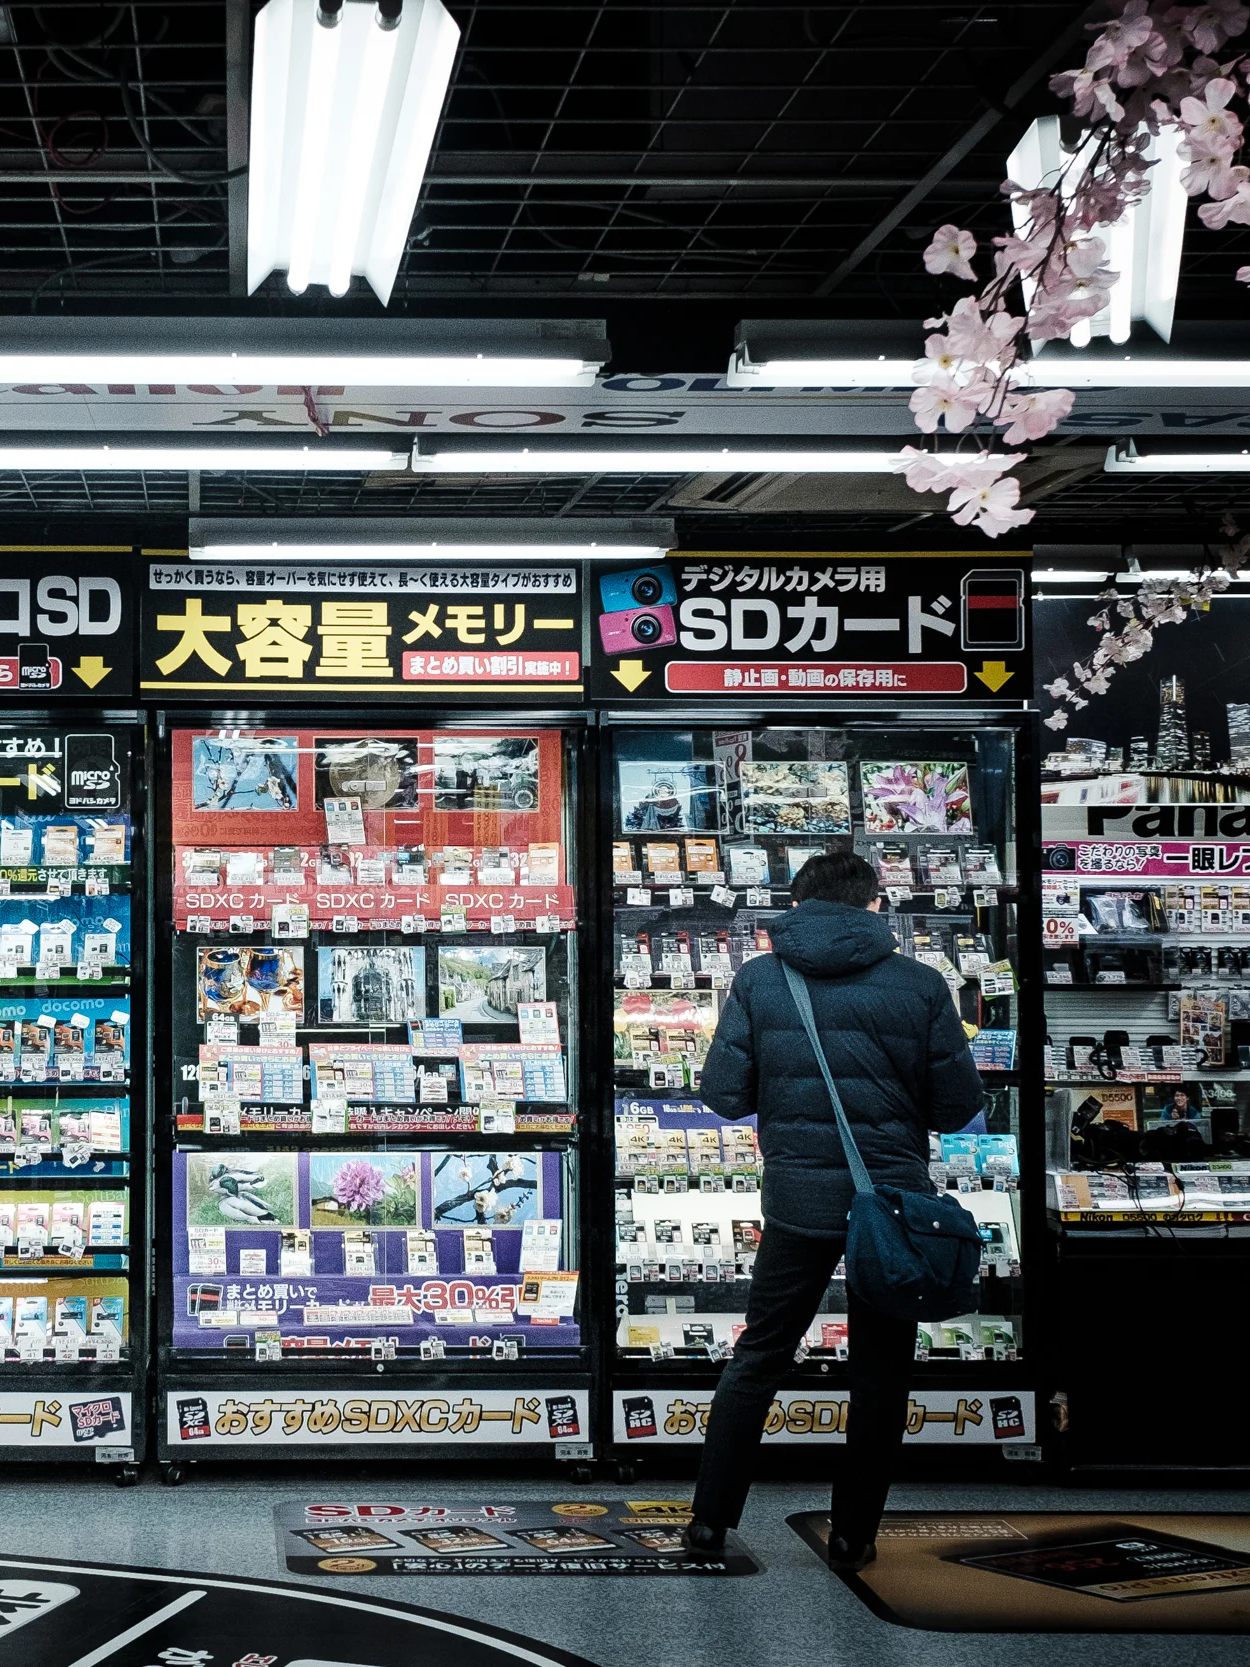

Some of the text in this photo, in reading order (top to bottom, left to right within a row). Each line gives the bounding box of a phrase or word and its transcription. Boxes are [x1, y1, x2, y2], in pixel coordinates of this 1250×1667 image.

[191, 409, 688, 430] SONY
[681, 566, 886, 593] デジタルカメラ用
[679, 595, 956, 654] SDカード
[155, 599, 574, 678] 大容量 メモリー
[724, 668, 907, 688] 静止画・動画の保存用に
[1079, 844, 1162, 858] こだわりの写真
[1165, 846, 1250, 872] 一眼レ
[185, 892, 301, 909] SDXC カード
[316, 892, 431, 909] SDXC カード
[444, 892, 561, 909] SDXC カード
[1042, 918, 1075, 934] 0%
[42, 997, 105, 1014] docomo
[180, 1064, 200, 1081] 12
[668, 1134, 684, 1144] 4K
[702, 1134, 717, 1144] 4K
[736, 1132, 752, 1142] 4K
[1080, 1211, 1113, 1222] Nikon
[226, 1283, 318, 1300] まとめ買いで
[370, 1280, 520, 1314] 最大30%引
[72, 1400, 112, 1415] マイクロ
[77, 1411, 121, 1428] SDカード
[305, 1504, 518, 1518] SDカード
